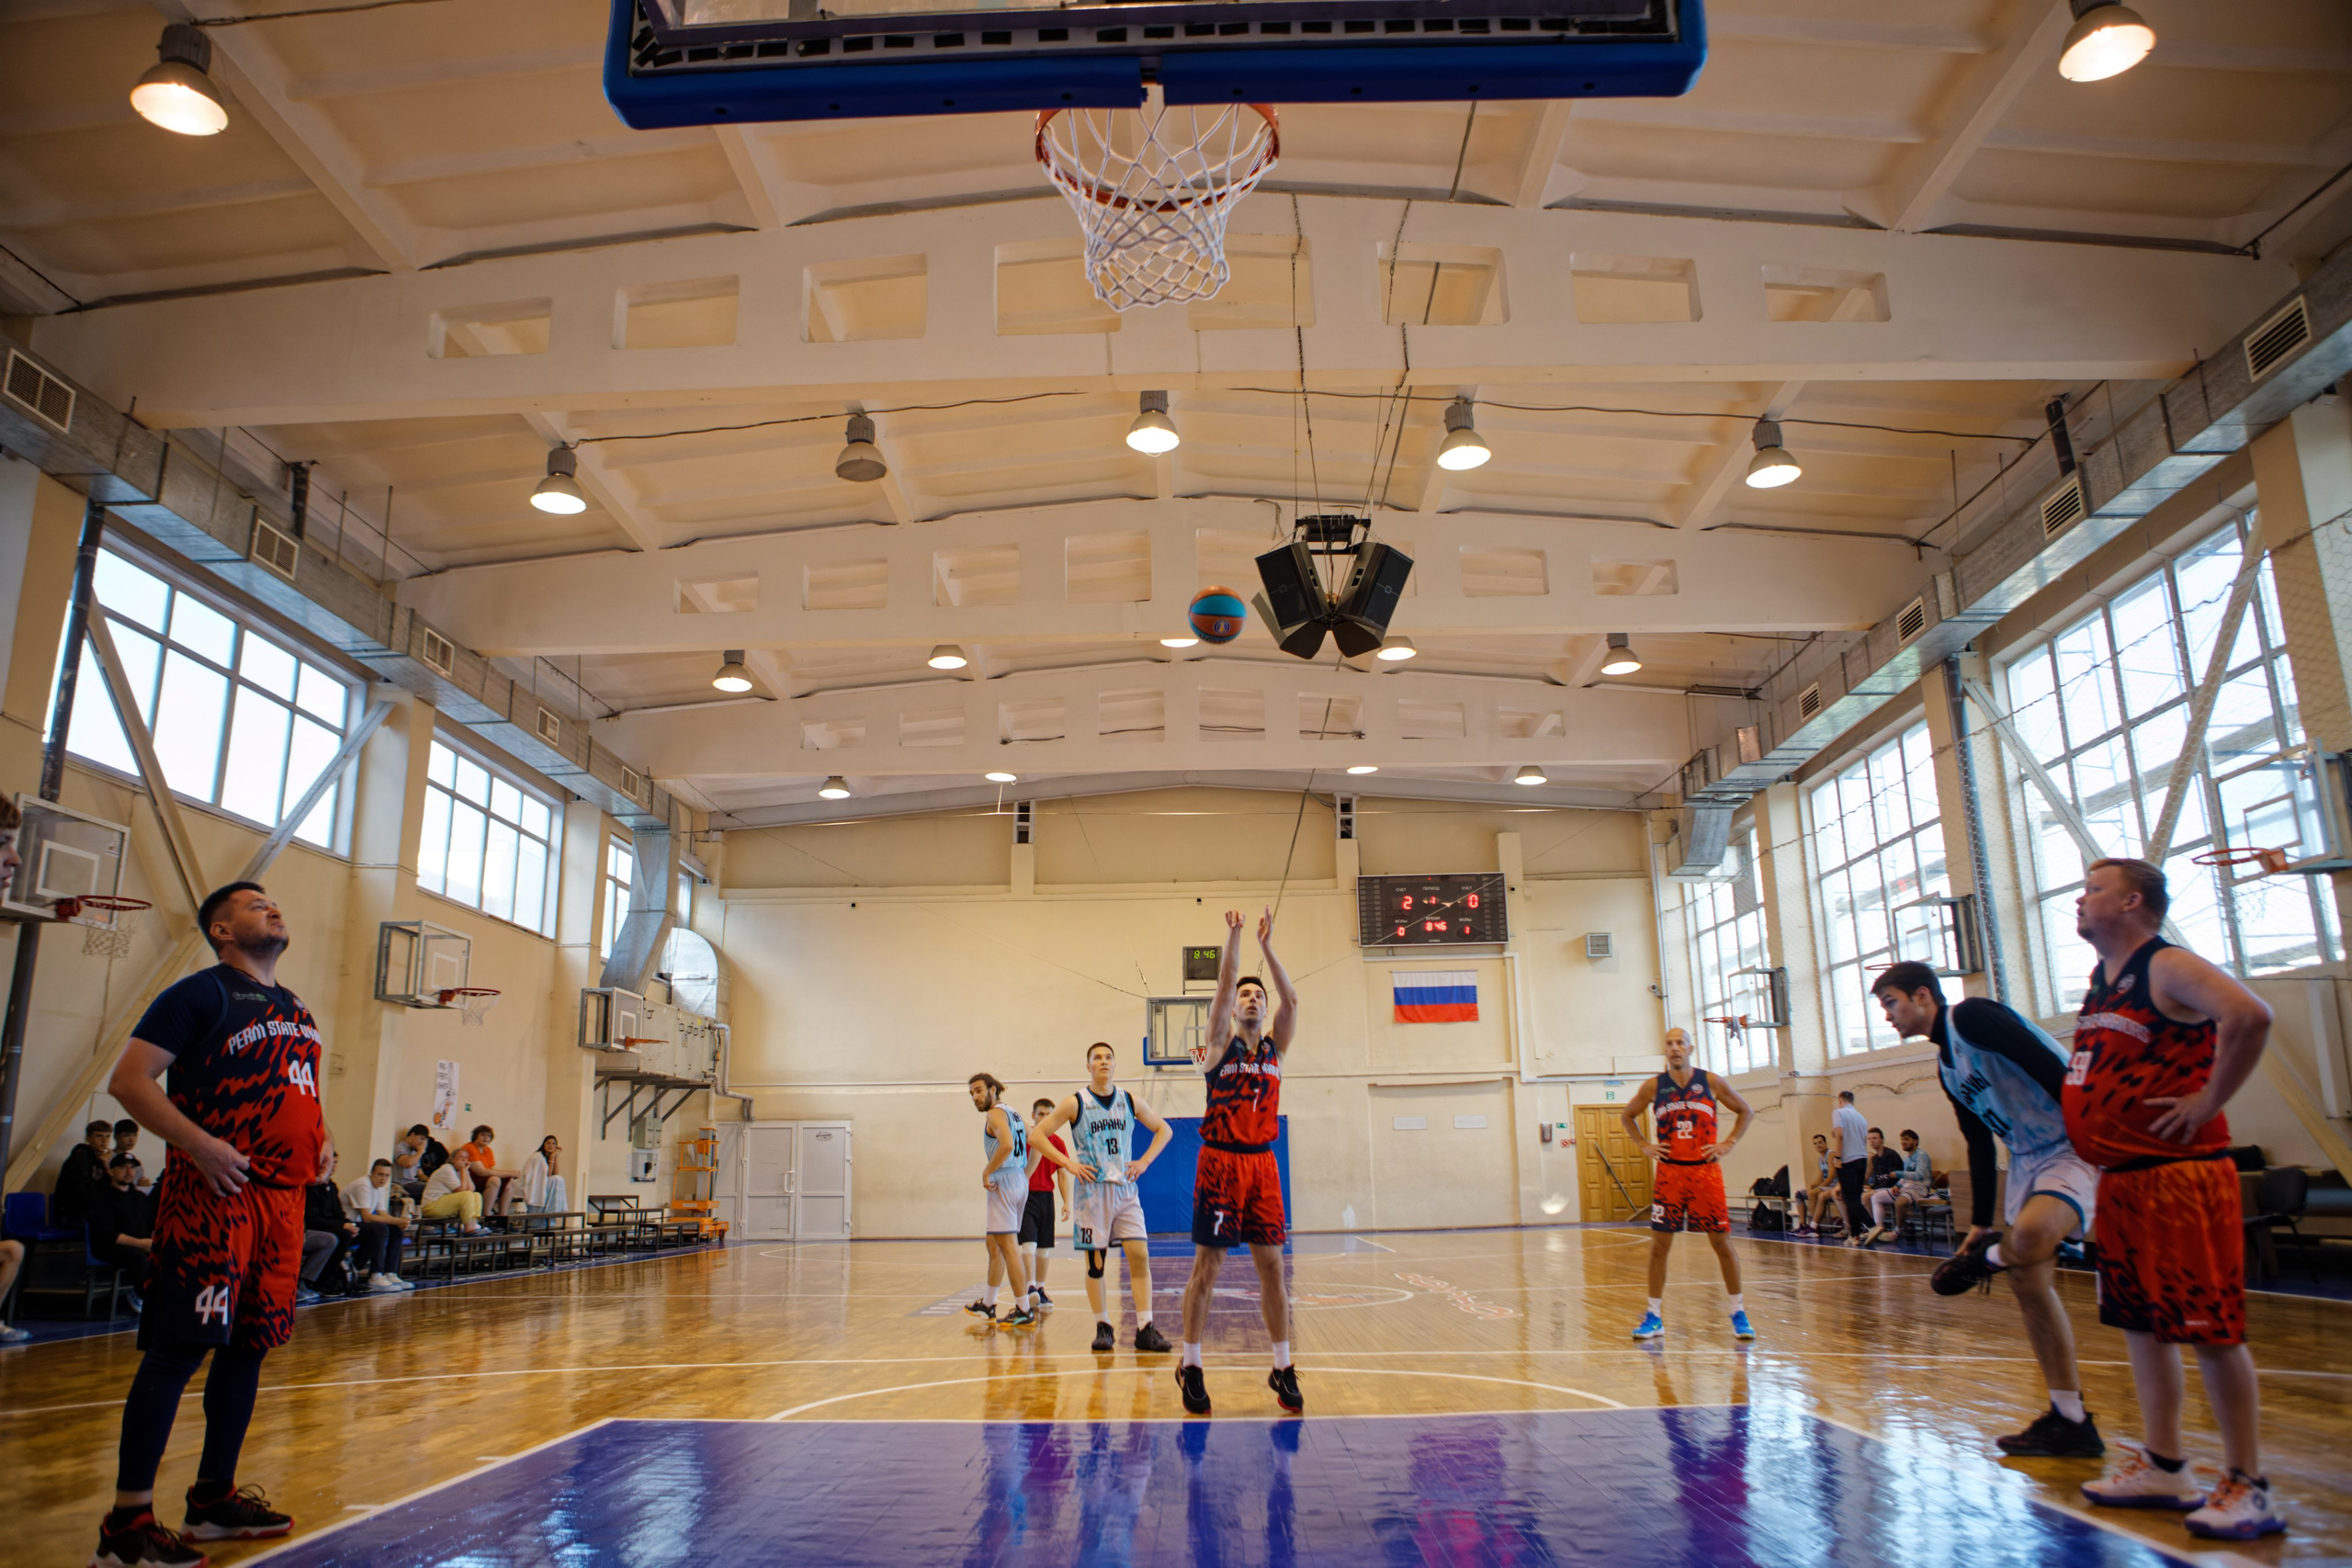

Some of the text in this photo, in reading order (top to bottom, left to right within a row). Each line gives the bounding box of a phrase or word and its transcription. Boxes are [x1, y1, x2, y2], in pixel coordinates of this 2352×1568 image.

[1402, 895, 1413, 909] 2
[1468, 893, 1479, 908] 0
[1396, 926, 1406, 937] 0
[228, 1023, 267, 1055] PERM
[266, 1021, 300, 1037] STATE
[1238, 1062, 1261, 1075] STATE
[288, 1059, 317, 1098] 44
[1091, 1118, 1126, 1134] ВАРАНЫ
[1677, 1120, 1694, 1139] 22
[1105, 1137, 1119, 1156] 13
[1214, 1210, 1224, 1236] 7
[1080, 1227, 1093, 1245] 13
[195, 1285, 230, 1325] 44
